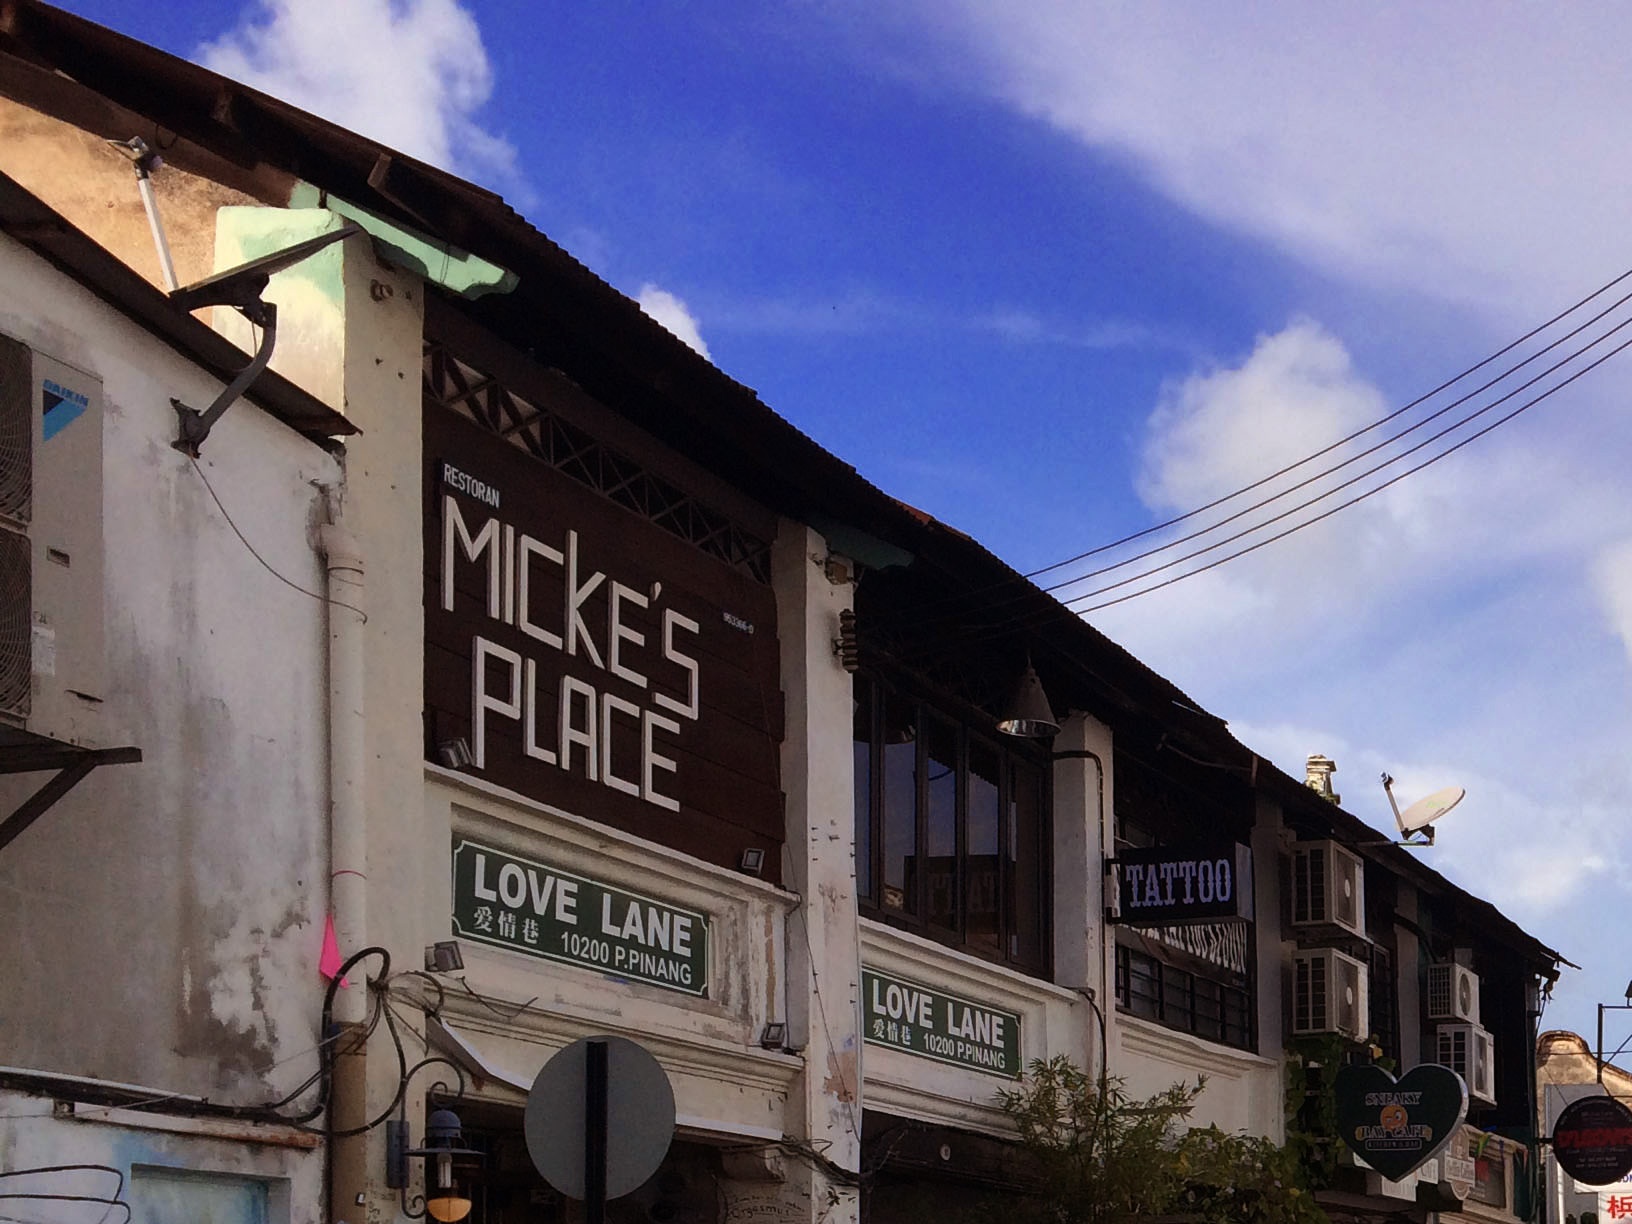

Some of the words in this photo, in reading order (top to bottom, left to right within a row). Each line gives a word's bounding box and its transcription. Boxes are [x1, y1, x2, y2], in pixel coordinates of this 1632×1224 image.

[43, 379, 89, 406] DAIKIN
[443, 463, 500, 508] RESTORAN
[441, 494, 700, 721] MICKE'S
[471, 635, 681, 813] PLACE
[473, 852, 580, 926] LOVE
[601, 892, 693, 959] LANE
[1124, 858, 1233, 908] TATTOO
[472, 905, 541, 947] 愛情巷
[560, 932, 610, 967] 10200
[613, 946, 693, 988] P.PINANG
[871, 1018, 913, 1047] 愛情巷
[872, 978, 934, 1031] LOVE
[946, 1001, 1006, 1050] LANE
[922, 1032, 956, 1059] 10200
[956, 1040, 1006, 1071] P.PINANG
[1364, 1091, 1423, 1107] SNEAKY
